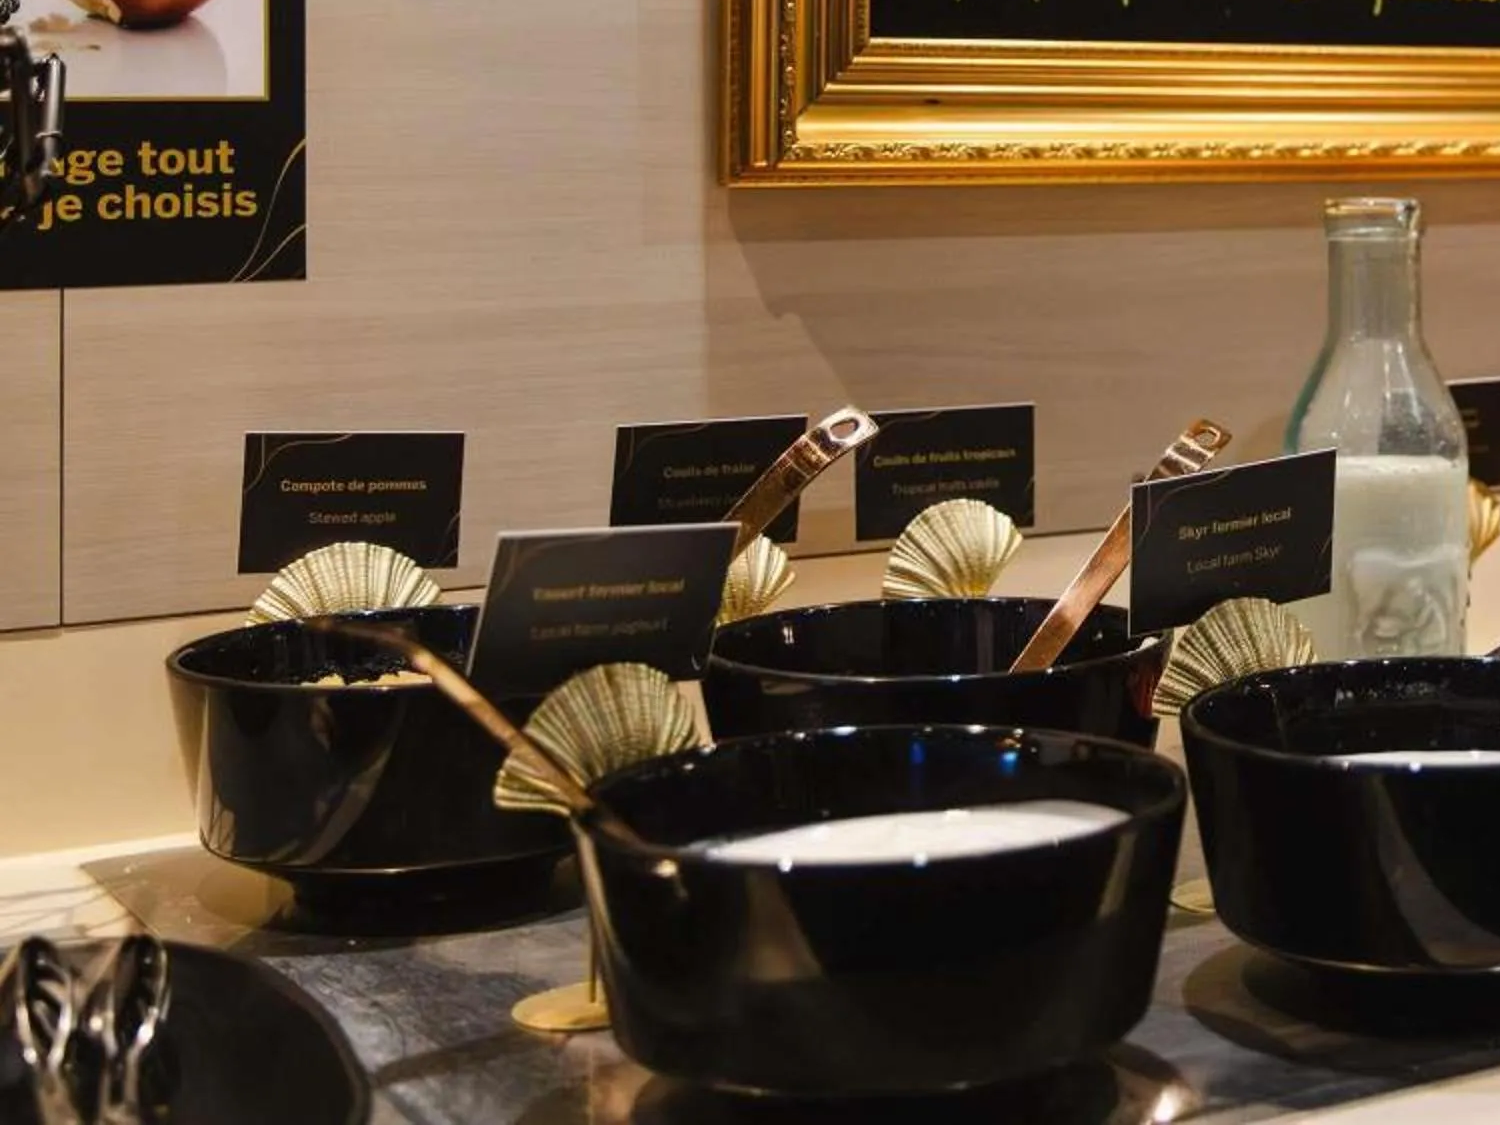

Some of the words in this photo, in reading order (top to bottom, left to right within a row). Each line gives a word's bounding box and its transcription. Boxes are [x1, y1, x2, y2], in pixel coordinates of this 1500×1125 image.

[138, 141, 235, 175] tout
[97, 182, 258, 220] choisis
[280, 480, 345, 495] Compote
[347, 480, 365, 492] de
[367, 481, 427, 495] pommes
[308, 512, 358, 525] Stewed
[360, 512, 397, 526] apple
[1178, 525, 1208, 540] Skyr
[1261, 507, 1292, 525] local
